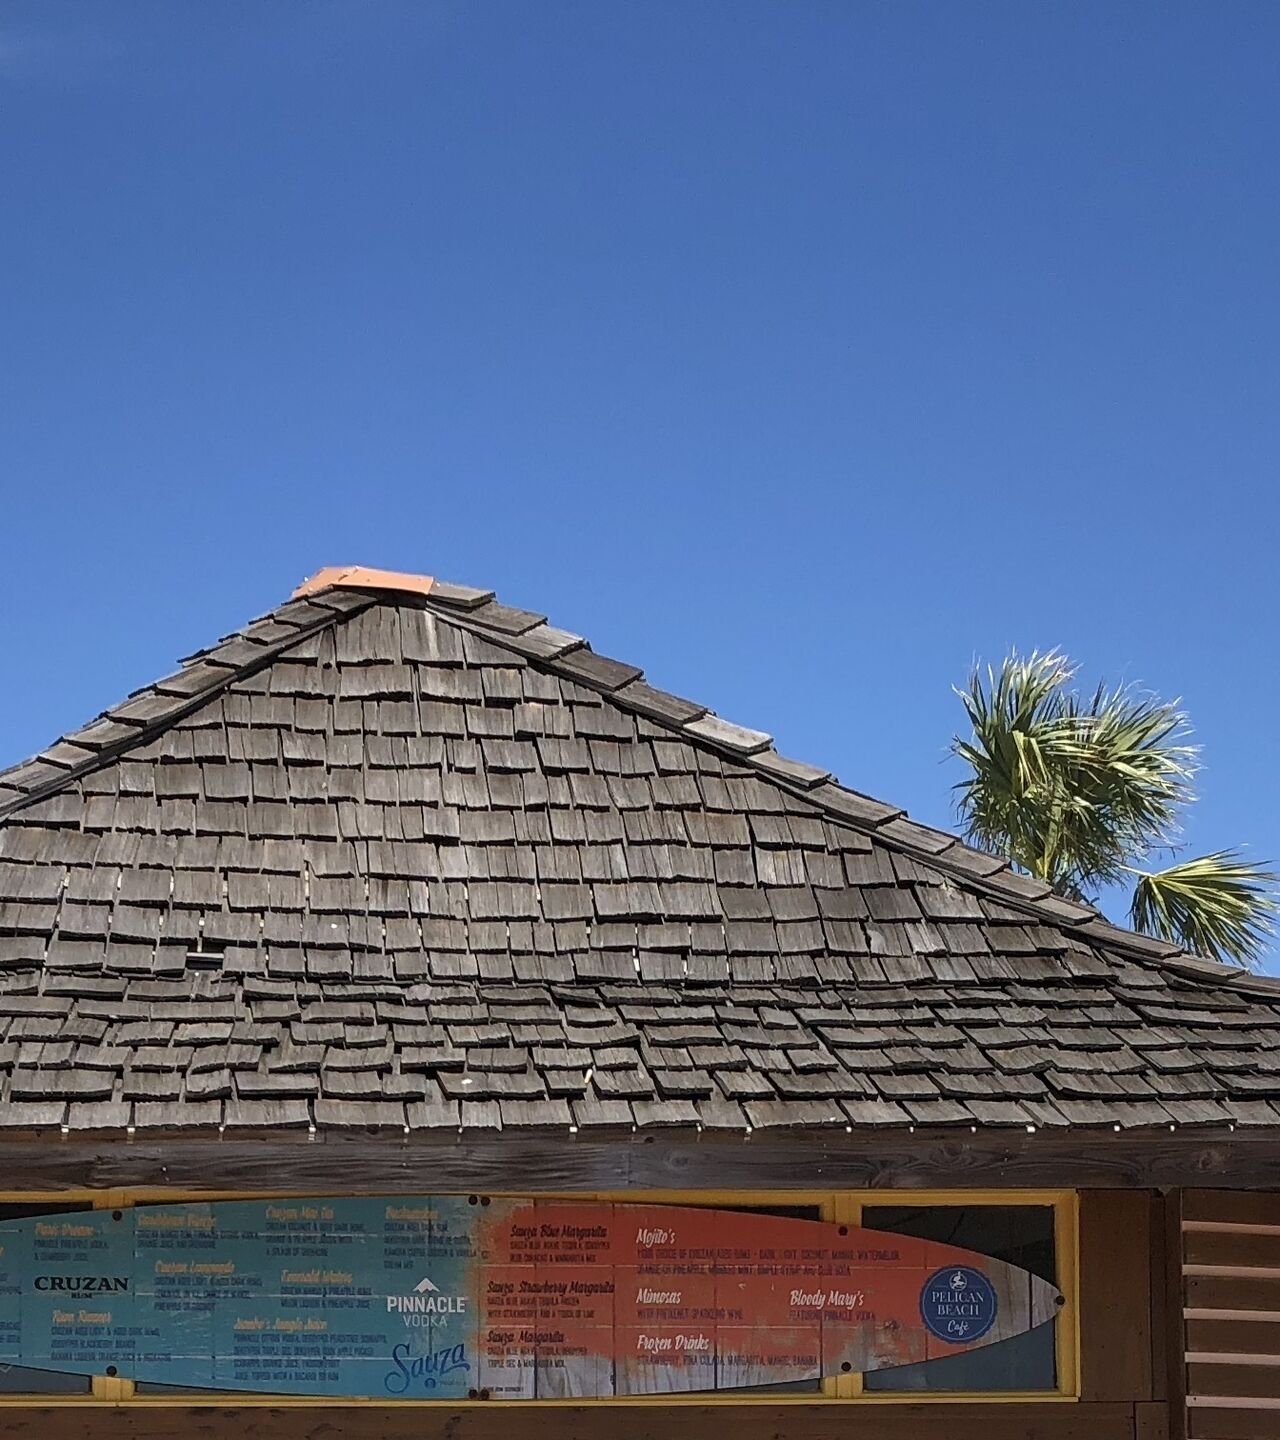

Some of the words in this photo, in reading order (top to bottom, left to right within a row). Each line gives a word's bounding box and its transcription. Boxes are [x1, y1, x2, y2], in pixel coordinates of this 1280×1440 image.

[636, 1228, 676, 1249] Mojito's
[34, 1276, 129, 1291] CRUZAN
[487, 1281, 514, 1297] Sauza
[518, 1280, 567, 1297] Strawberry
[568, 1280, 615, 1297] Margarita
[636, 1288, 681, 1304] Mimosas
[790, 1289, 826, 1310] Bloody
[827, 1290, 864, 1310] Mary's
[932, 1291, 984, 1303] PELICAN
[387, 1296, 465, 1313] PINNACLE
[938, 1304, 979, 1315] BEACH
[403, 1314, 448, 1328] VODKA
[487, 1330, 515, 1346] Sauza
[519, 1330, 566, 1346] Margarita
[637, 1334, 672, 1354] Frozen
[675, 1333, 709, 1351] Drinks
[385, 1343, 470, 1393] Sauza
